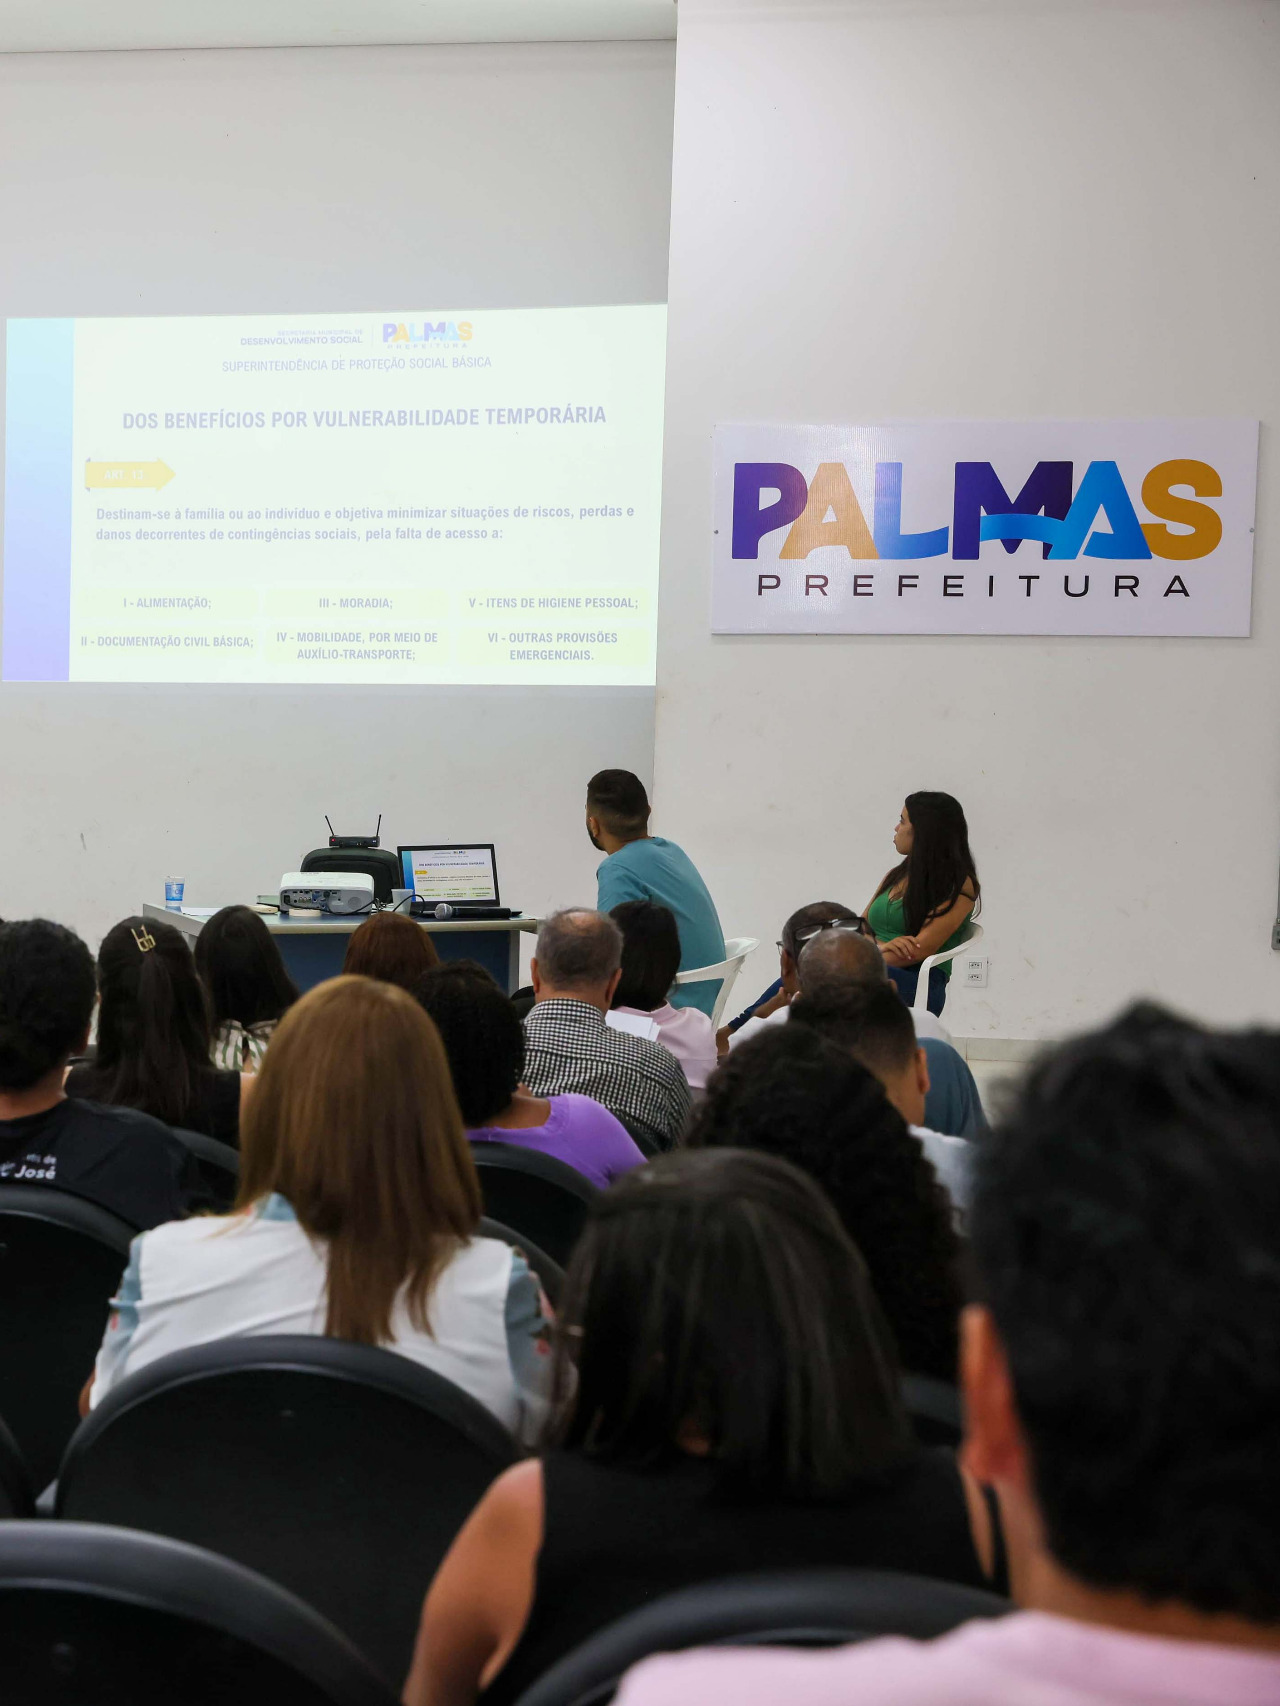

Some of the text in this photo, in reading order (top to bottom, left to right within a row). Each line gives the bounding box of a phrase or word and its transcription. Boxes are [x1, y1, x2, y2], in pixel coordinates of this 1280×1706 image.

[382, 321, 473, 343] PALMAS
[240, 335, 364, 346] DESENVOLVIMENTO SOCIAL
[221, 355, 492, 373] SUPERINTENDÊNCIA DE PROTEÇÃO SOCIAL BÁSICA
[122, 402, 607, 430] DOS BENEFÍCIOS POR VULNERABILIDADE TEMPORÁRIA
[96, 507, 171, 521] Destinam-se
[184, 507, 225, 520] família
[228, 510, 244, 520] ou
[247, 510, 262, 520] ao
[264, 506, 320, 520] indivíduo
[334, 506, 384, 523] objetiva
[386, 506, 448, 519] minimizar
[449, 505, 510, 522] situações
[512, 505, 530, 519] de
[532, 505, 575, 520] riscos,
[579, 504, 623, 521] perdas
[731, 459, 1222, 561] PALMAS
[95, 527, 503, 543] danos decorrentes de contingências sociais, pela falta de acesso a:
[757, 574, 1191, 598] PREFEITURA
[136, 595, 212, 611] ALIMENTAÇÃO;
[318, 597, 330, 609] III
[339, 597, 393, 610] MORADIA;
[486, 597, 518, 609] ITENS
[520, 597, 536, 609] DE
[538, 597, 582, 609] HIGIENE
[584, 597, 639, 610] PESSOAL;
[97, 634, 182, 650] DOCUMENTAÇÃO
[183, 636, 211, 648] CIVIL
[212, 634, 254, 649] BÁSICA;
[276, 631, 288, 643] IV
[296, 631, 365, 645] MOBILIDADE,
[368, 632, 391, 643] POR
[393, 632, 421, 643] MEIO
[423, 632, 438, 643] DE
[487, 632, 498, 643] VI
[508, 632, 553, 644] OUTRAS
[556, 630, 618, 644] PROVISÕES
[296, 647, 416, 662] AUXÍLIO-TRANSPORTE;
[509, 649, 595, 661] EMERGENCIAIS.
[14, 1165, 56, 1180] José
